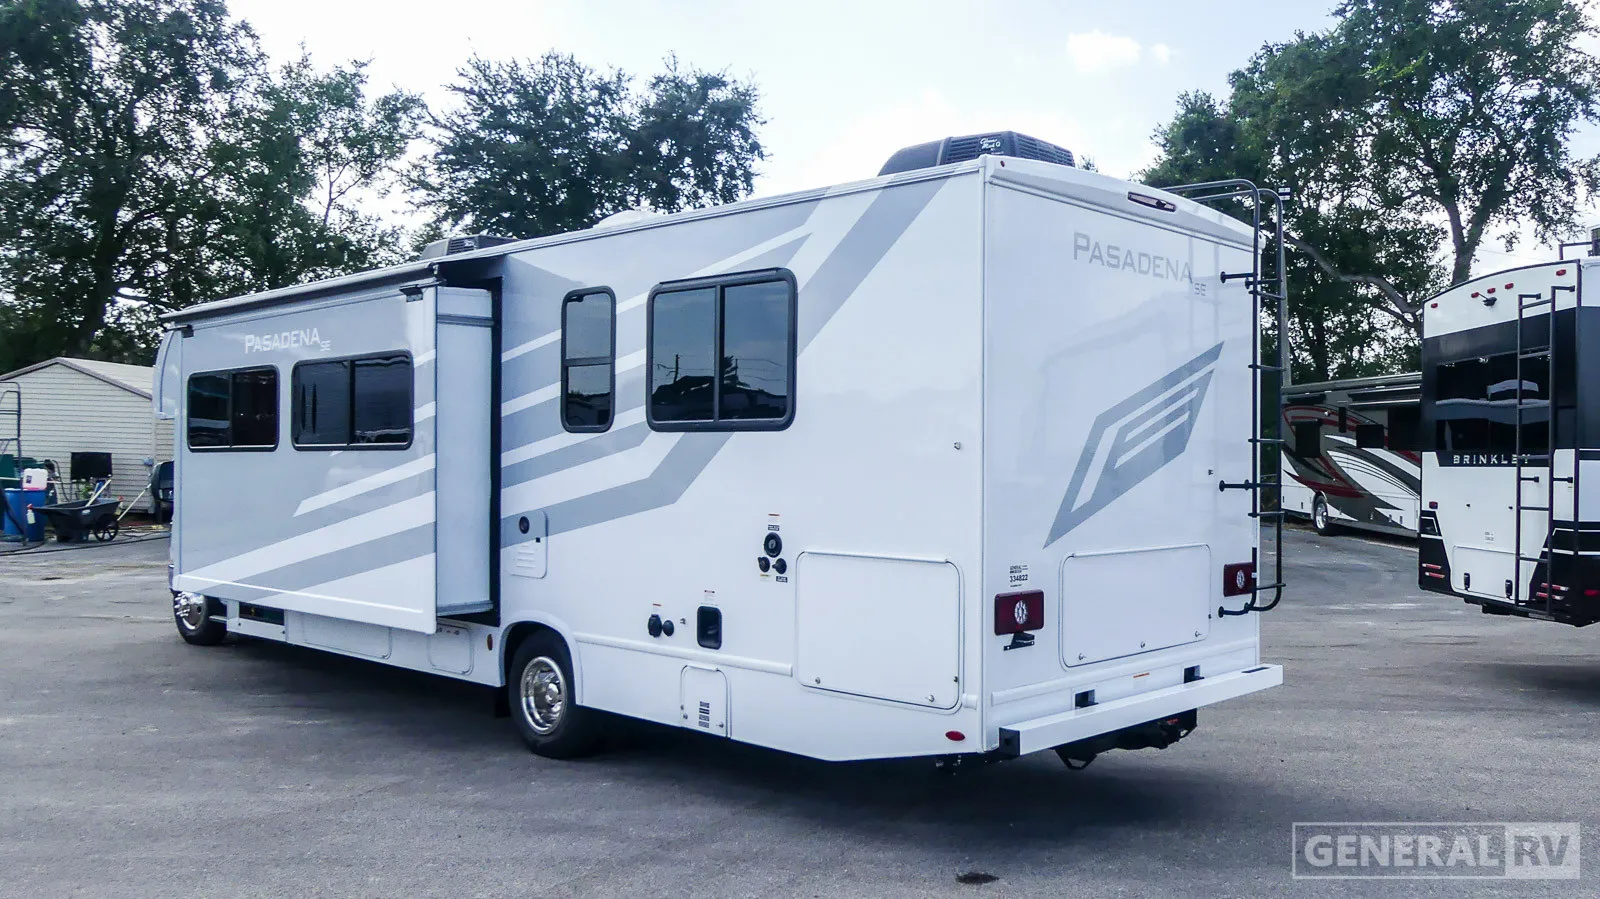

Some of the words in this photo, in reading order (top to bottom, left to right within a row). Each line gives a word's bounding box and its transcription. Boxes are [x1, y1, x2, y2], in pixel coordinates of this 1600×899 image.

[1073, 231, 1193, 284] PASADENA
[1194, 282, 1206, 296] SE
[244, 327, 320, 354] PASADENA
[320, 340, 331, 352] SE
[1453, 454, 1530, 464] BRINKLEY
[1009, 574, 1028, 582] 334822
